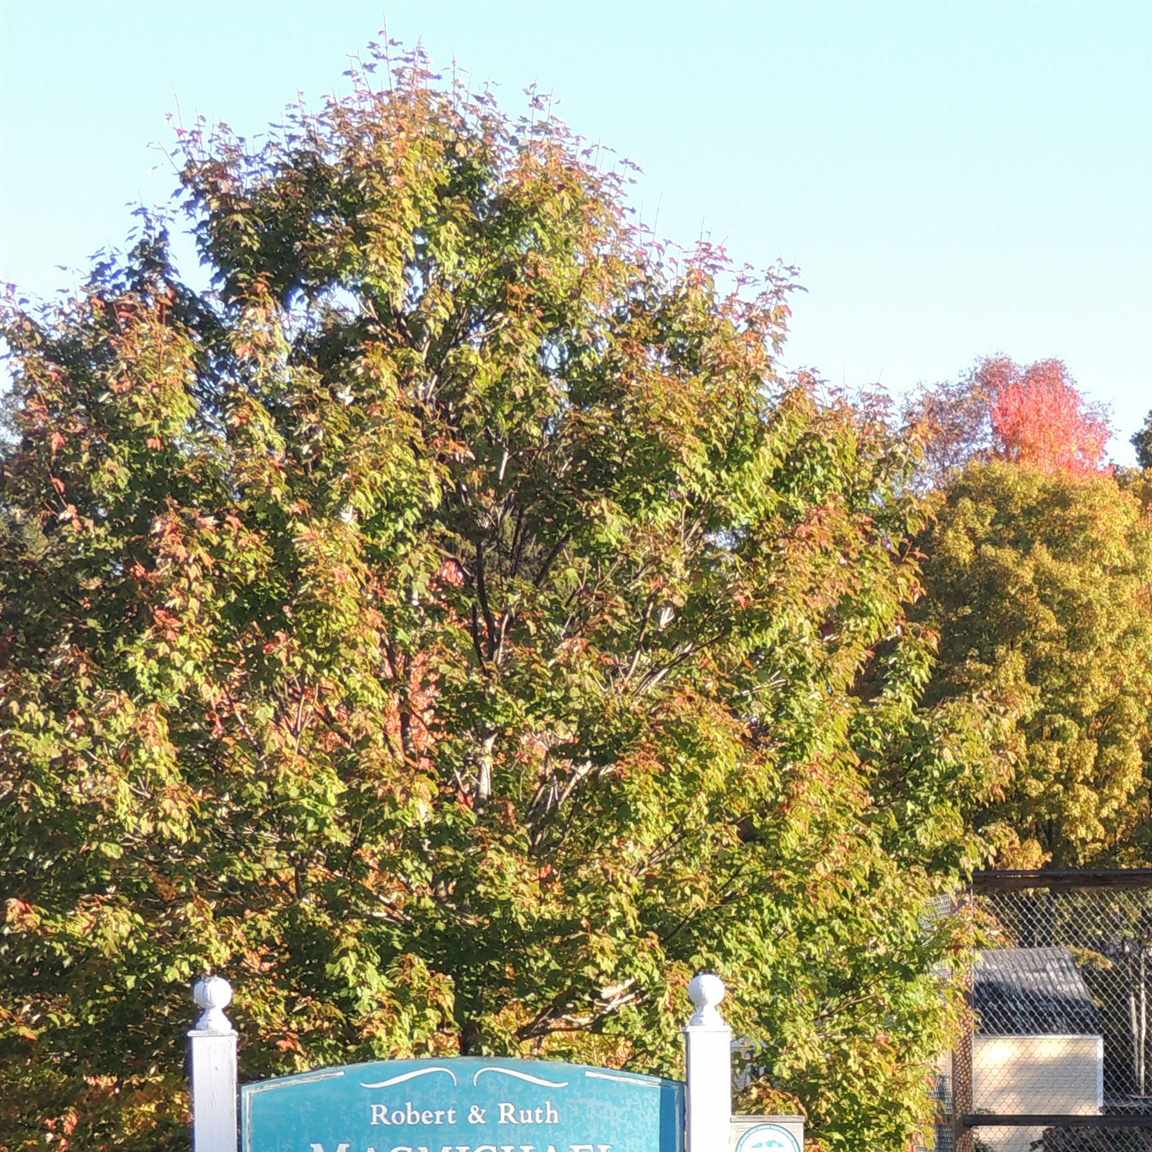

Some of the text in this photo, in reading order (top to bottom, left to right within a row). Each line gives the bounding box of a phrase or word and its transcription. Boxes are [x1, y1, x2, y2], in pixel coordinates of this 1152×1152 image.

[370, 1102, 560, 1126] Robert & Ruth
